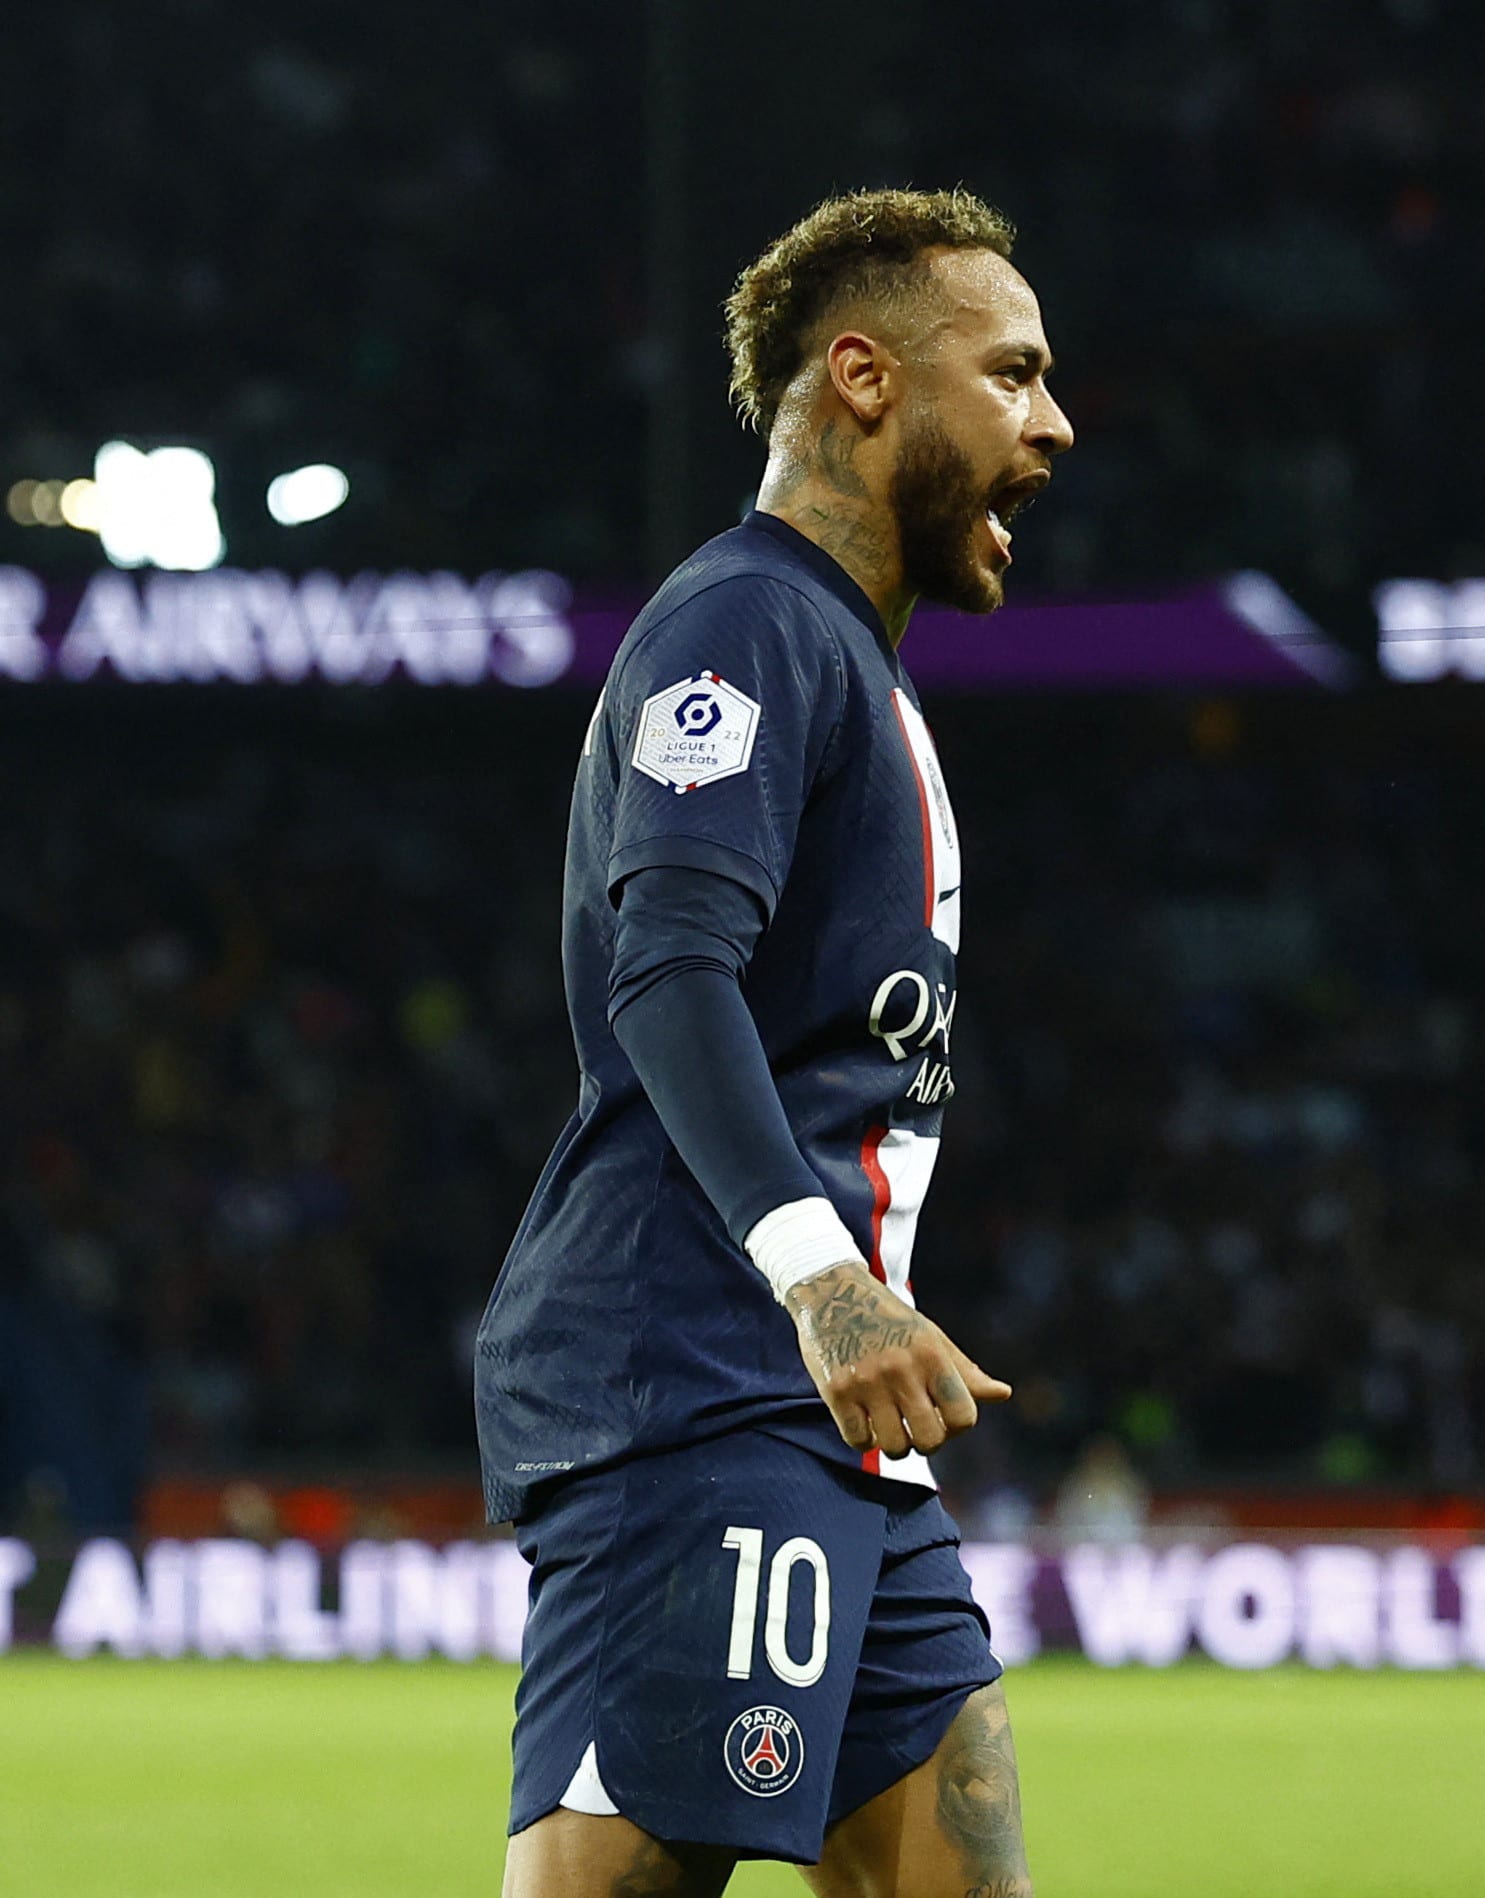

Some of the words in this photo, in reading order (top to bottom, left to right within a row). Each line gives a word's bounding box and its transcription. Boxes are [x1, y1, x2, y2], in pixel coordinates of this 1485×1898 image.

[667, 742, 706, 751] LIGUE
[659, 753, 686, 763] Uber
[689, 754, 718, 765] Eats
[722, 1526, 831, 1687] 10
[741, 1710, 793, 1735] PARIS
